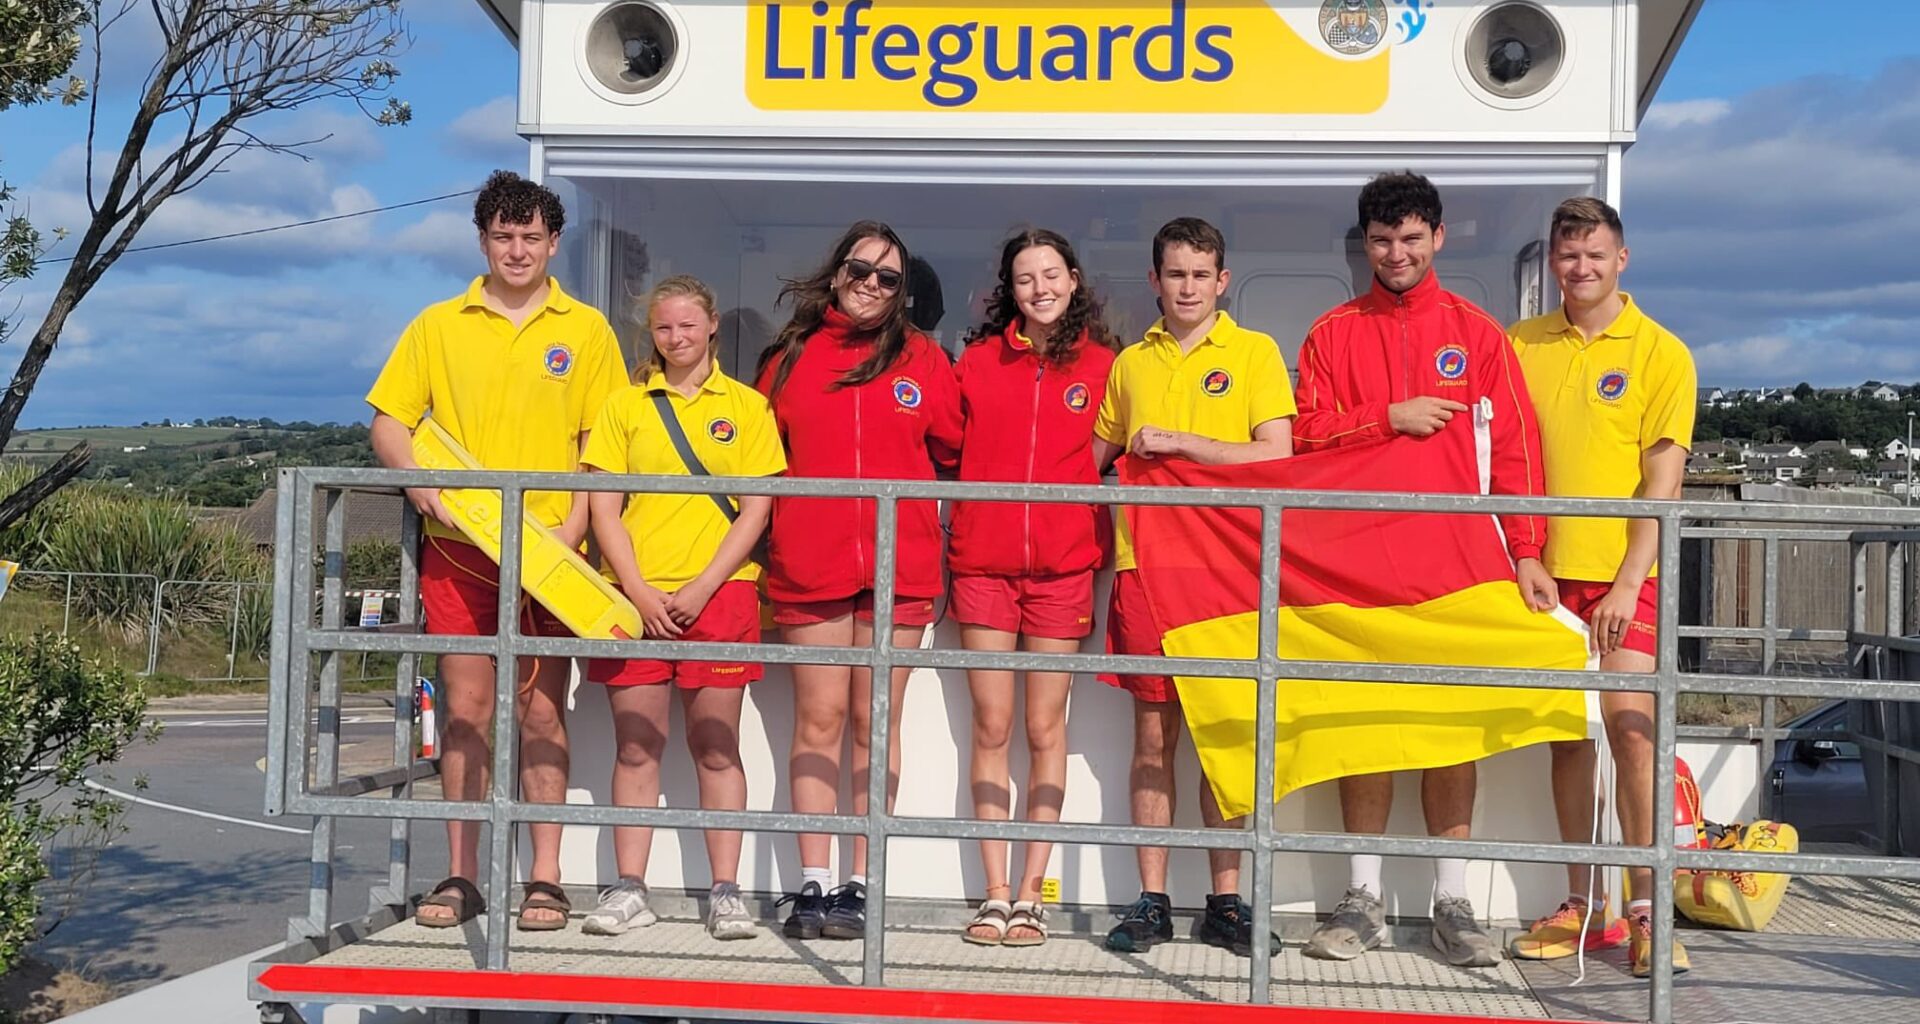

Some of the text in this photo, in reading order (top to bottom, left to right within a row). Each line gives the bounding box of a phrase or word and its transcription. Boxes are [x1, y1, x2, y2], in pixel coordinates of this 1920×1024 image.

[763, 0, 1235, 107] Lifeguards
[1435, 379, 1468, 387] LIFEGUARD
[711, 665, 745, 674] LIFEGUARD
